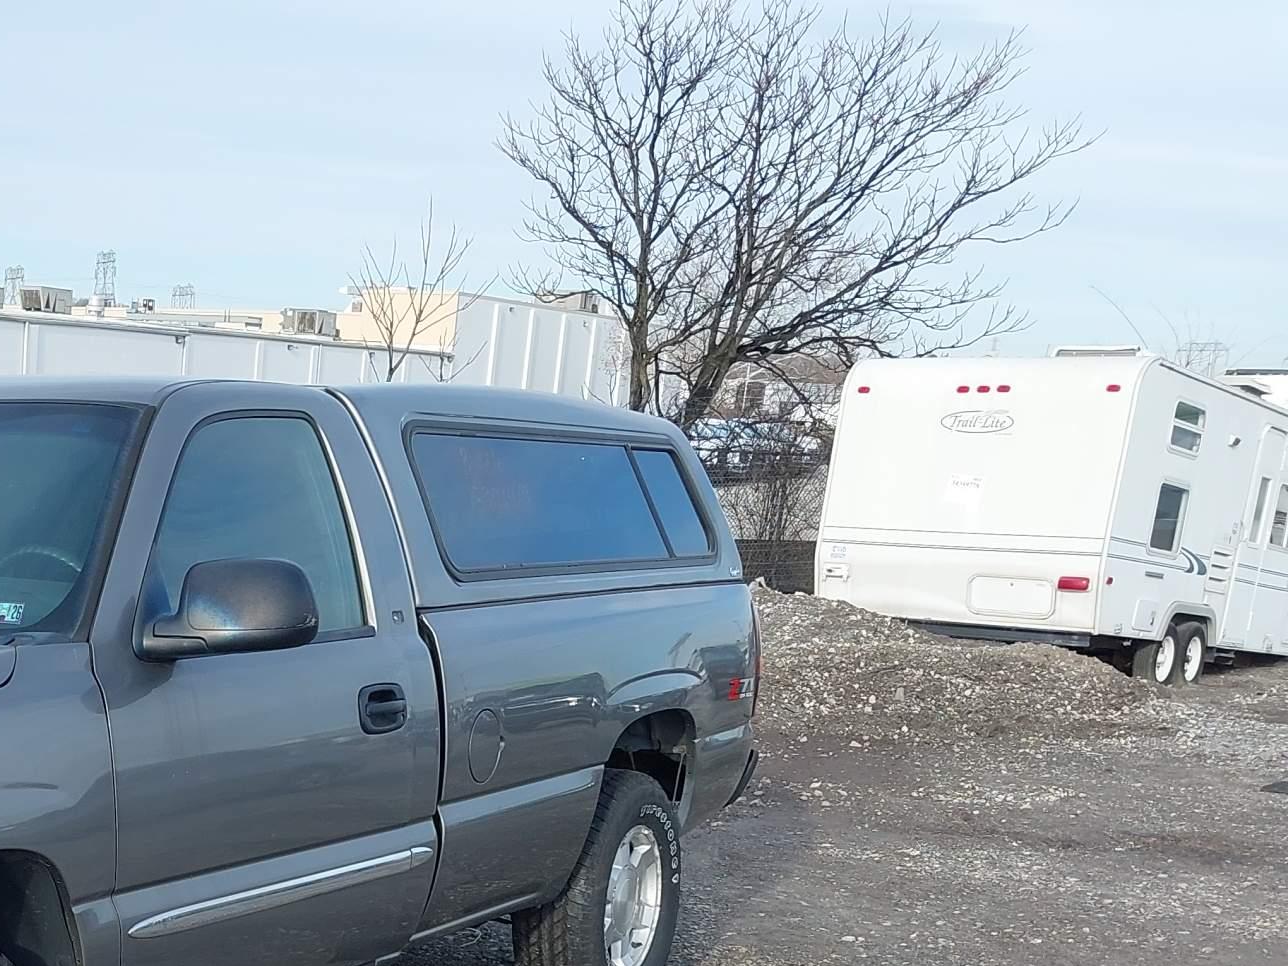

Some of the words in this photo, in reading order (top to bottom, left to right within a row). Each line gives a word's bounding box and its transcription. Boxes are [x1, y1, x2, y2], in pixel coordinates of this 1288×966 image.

[950, 414, 1007, 429] Trail-Lite
[11, 605, 23, 620] 26
[727, 676, 755, 701] Z71
